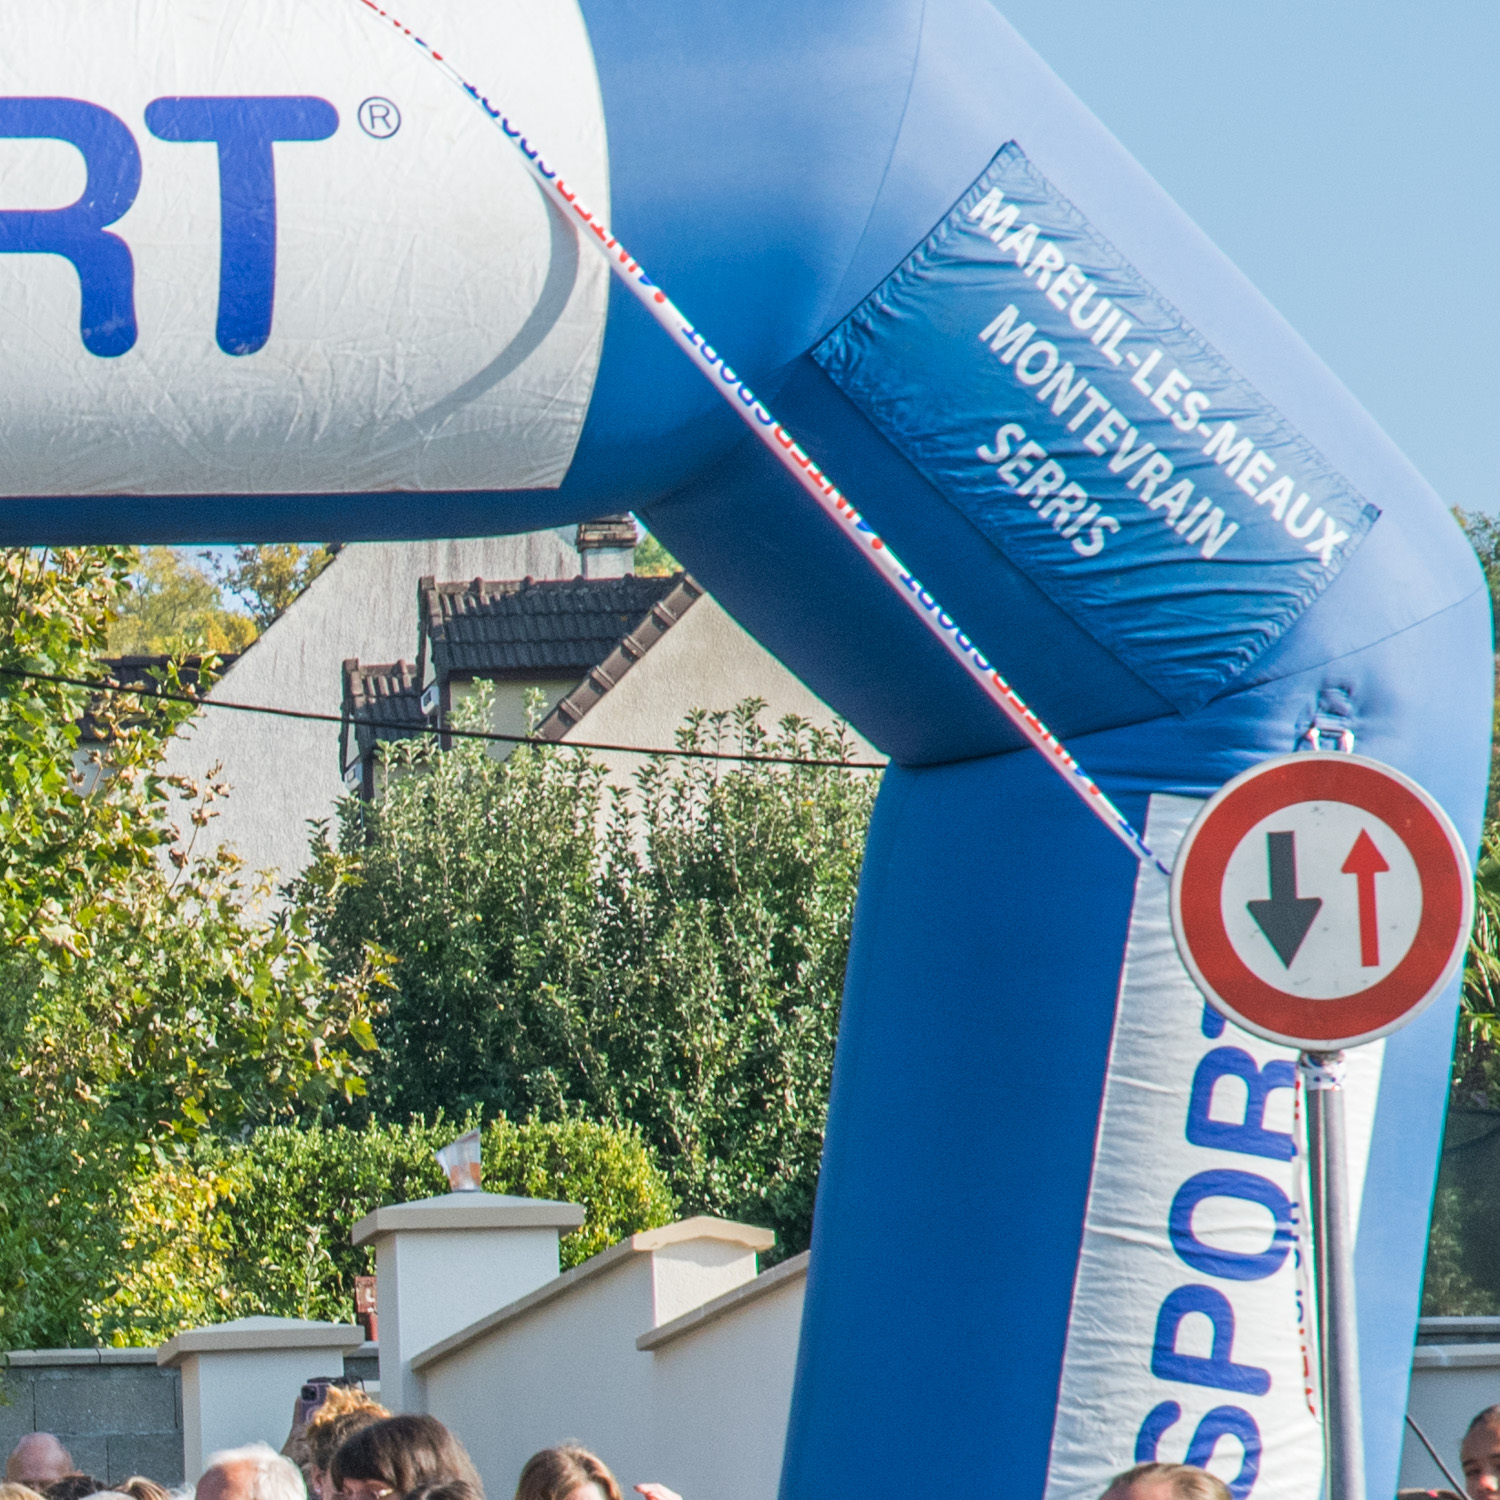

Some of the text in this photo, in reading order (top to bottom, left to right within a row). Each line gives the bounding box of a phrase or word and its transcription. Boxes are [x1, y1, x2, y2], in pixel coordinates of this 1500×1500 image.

[967, 186, 1350, 568] MAREUIL-LES-MEAUX
[976, 422, 1122, 558] SERRIS
[978, 303, 1240, 560] MONTEVRAIN
